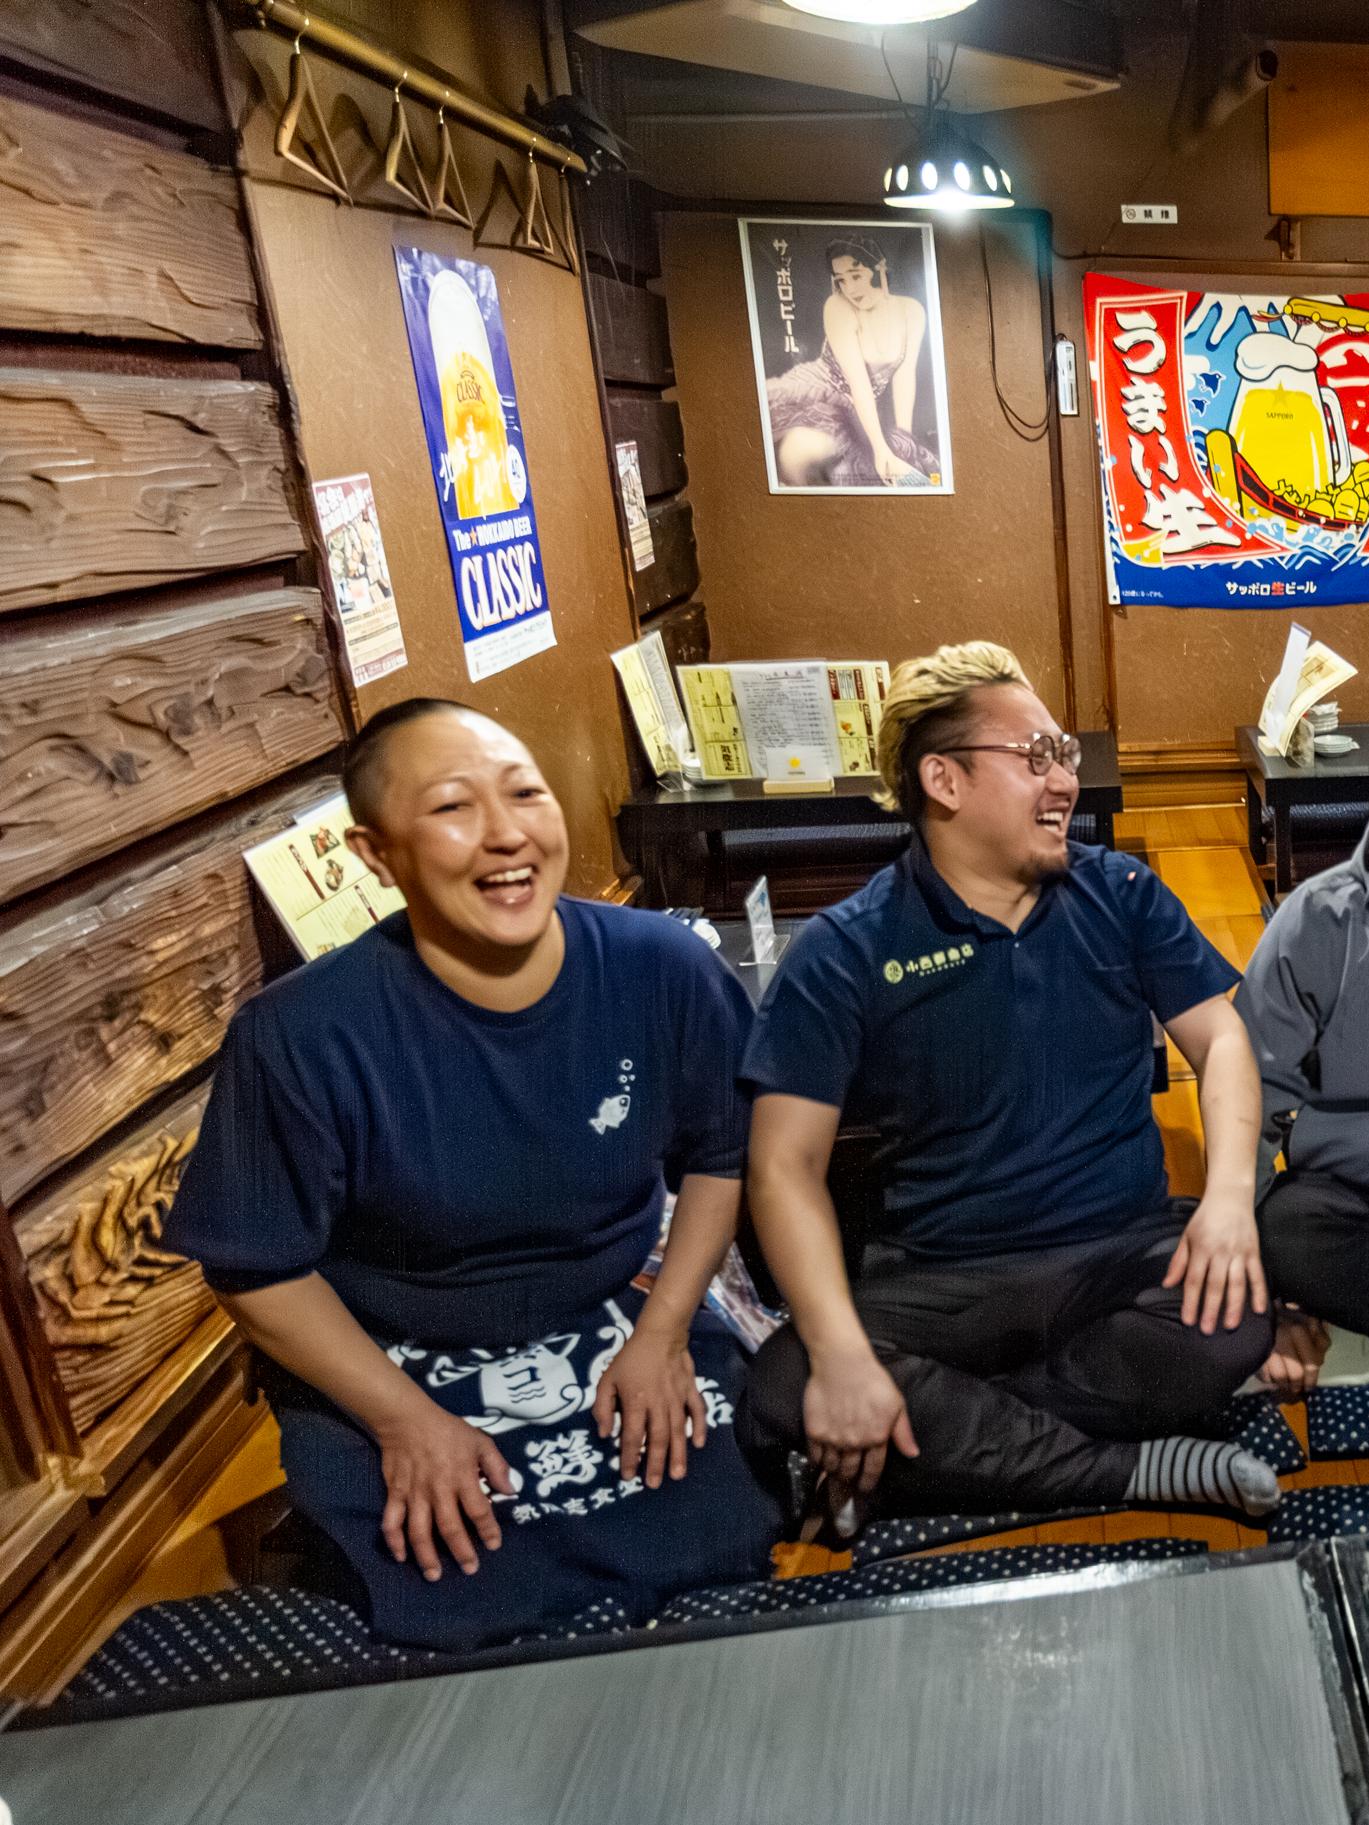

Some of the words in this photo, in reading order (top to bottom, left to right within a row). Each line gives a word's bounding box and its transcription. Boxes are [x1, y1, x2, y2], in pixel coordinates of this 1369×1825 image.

[772, 238, 800, 353] サッポロビール
[1112, 310, 1242, 554] うまい生
[1266, 411, 1294, 420] SAPPORO
[453, 529, 472, 551] The
[461, 541, 542, 631] CLASSIC
[1225, 580, 1317, 597] サッポロ生ビール
